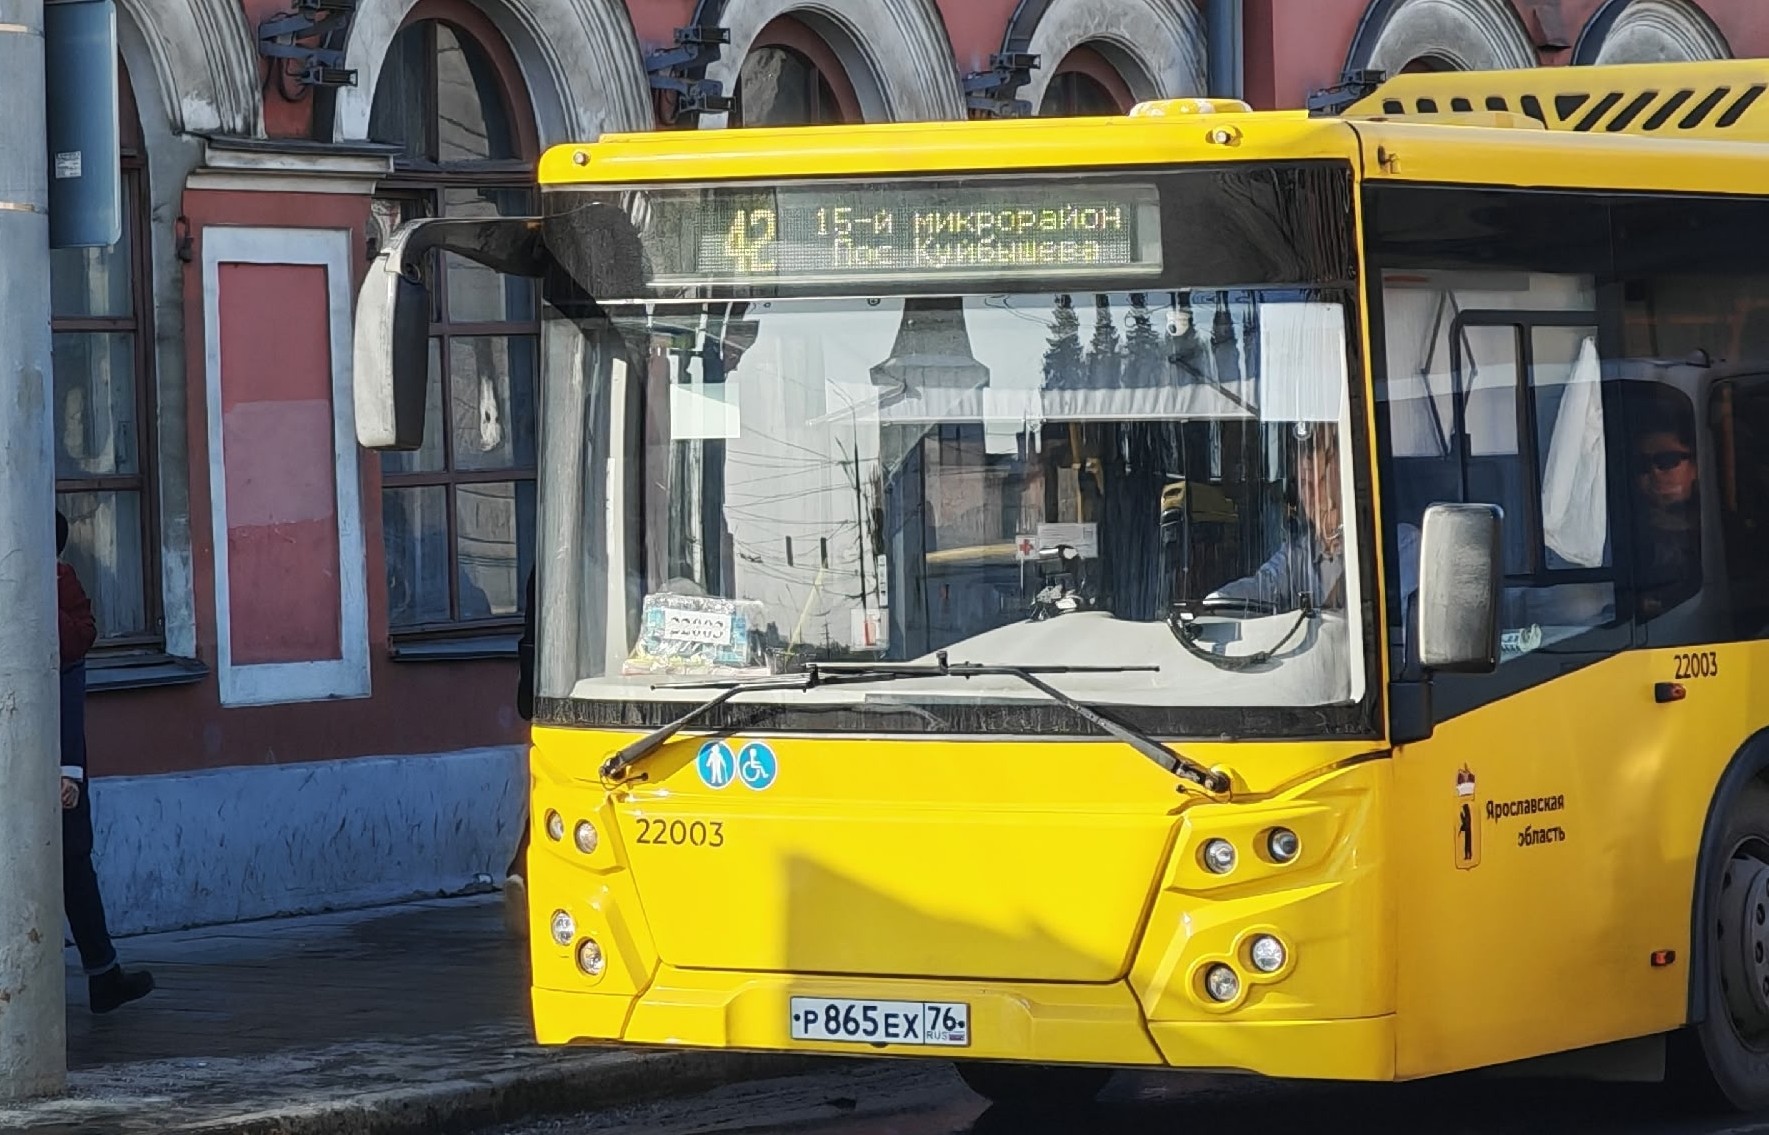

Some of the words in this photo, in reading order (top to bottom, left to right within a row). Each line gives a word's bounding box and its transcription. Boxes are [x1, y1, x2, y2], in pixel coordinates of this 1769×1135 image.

[817, 207, 893, 235] 15-й
[915, 203, 1122, 235] микрорайон
[725, 209, 776, 271] 42
[834, 238, 893, 267] Пос
[1674, 651, 1718, 679] 22003
[1486, 794, 1565, 823] Ярославская
[636, 818, 724, 847] 22003
[1517, 824, 1565, 847] область
[927, 1005, 957, 1031] 76
[926, 1030, 949, 1040] RUS
